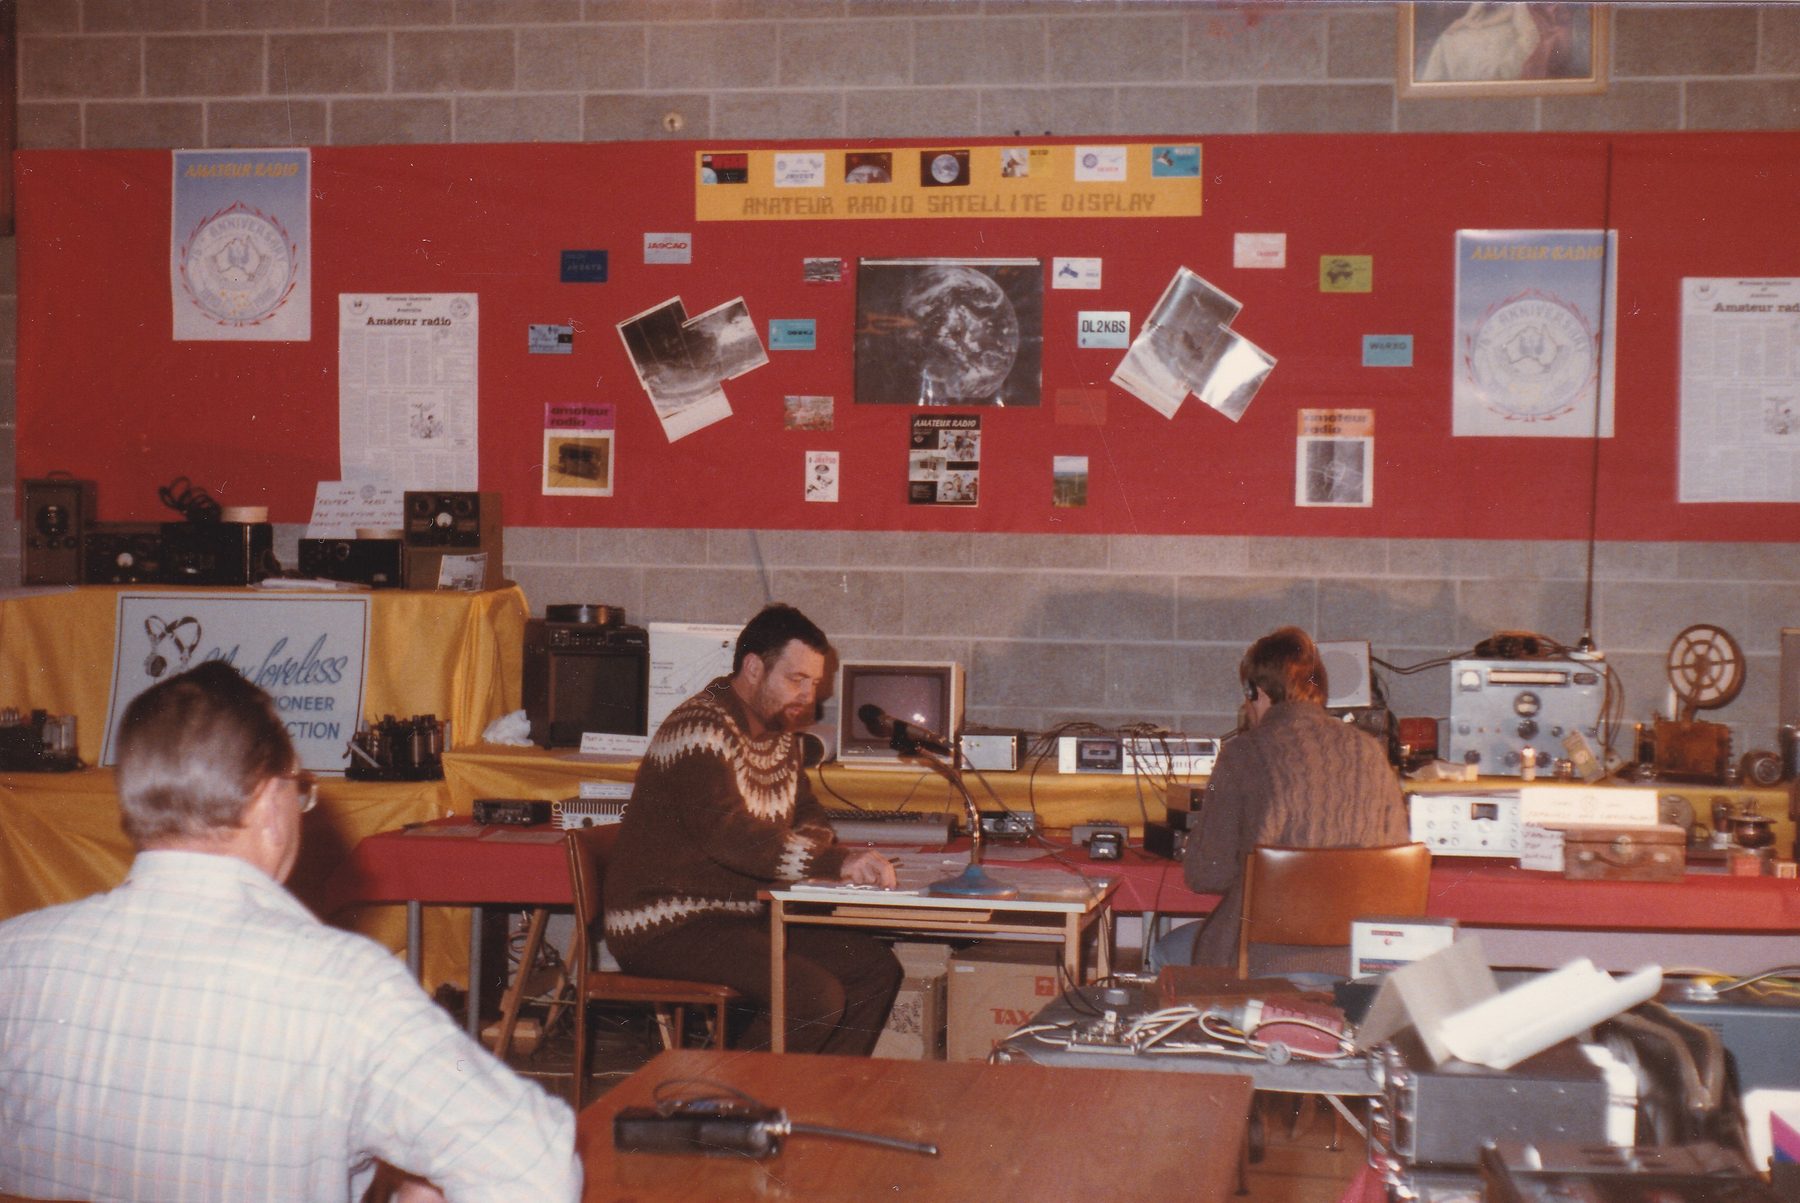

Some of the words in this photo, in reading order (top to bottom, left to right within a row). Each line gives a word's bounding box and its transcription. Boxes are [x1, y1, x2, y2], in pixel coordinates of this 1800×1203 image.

[185, 162, 253, 177] AMATEUR
[256, 162, 299, 177] RADIO
[742, 196, 834, 215] AMATEUR
[847, 195, 914, 214] RADIO
[928, 194, 1047, 214] SATELLITE
[1061, 192, 1156, 212] DISPLAY
[1471, 245, 1548, 261] AMATEUR
[1713, 302, 1774, 313] Amateur
[1777, 302, 1800, 313] rad
[366, 317, 417, 326] Amateur
[421, 316, 451, 326] radio
[1081, 320, 1126, 333] DL2KBS
[550, 406, 608, 416] amateur
[550, 417, 586, 426] radio
[914, 419, 952, 427] AMATEUR
[952, 419, 976, 427] RADIO
[273, 696, 335, 712] IONEER
[286, 721, 340, 739] CTION
